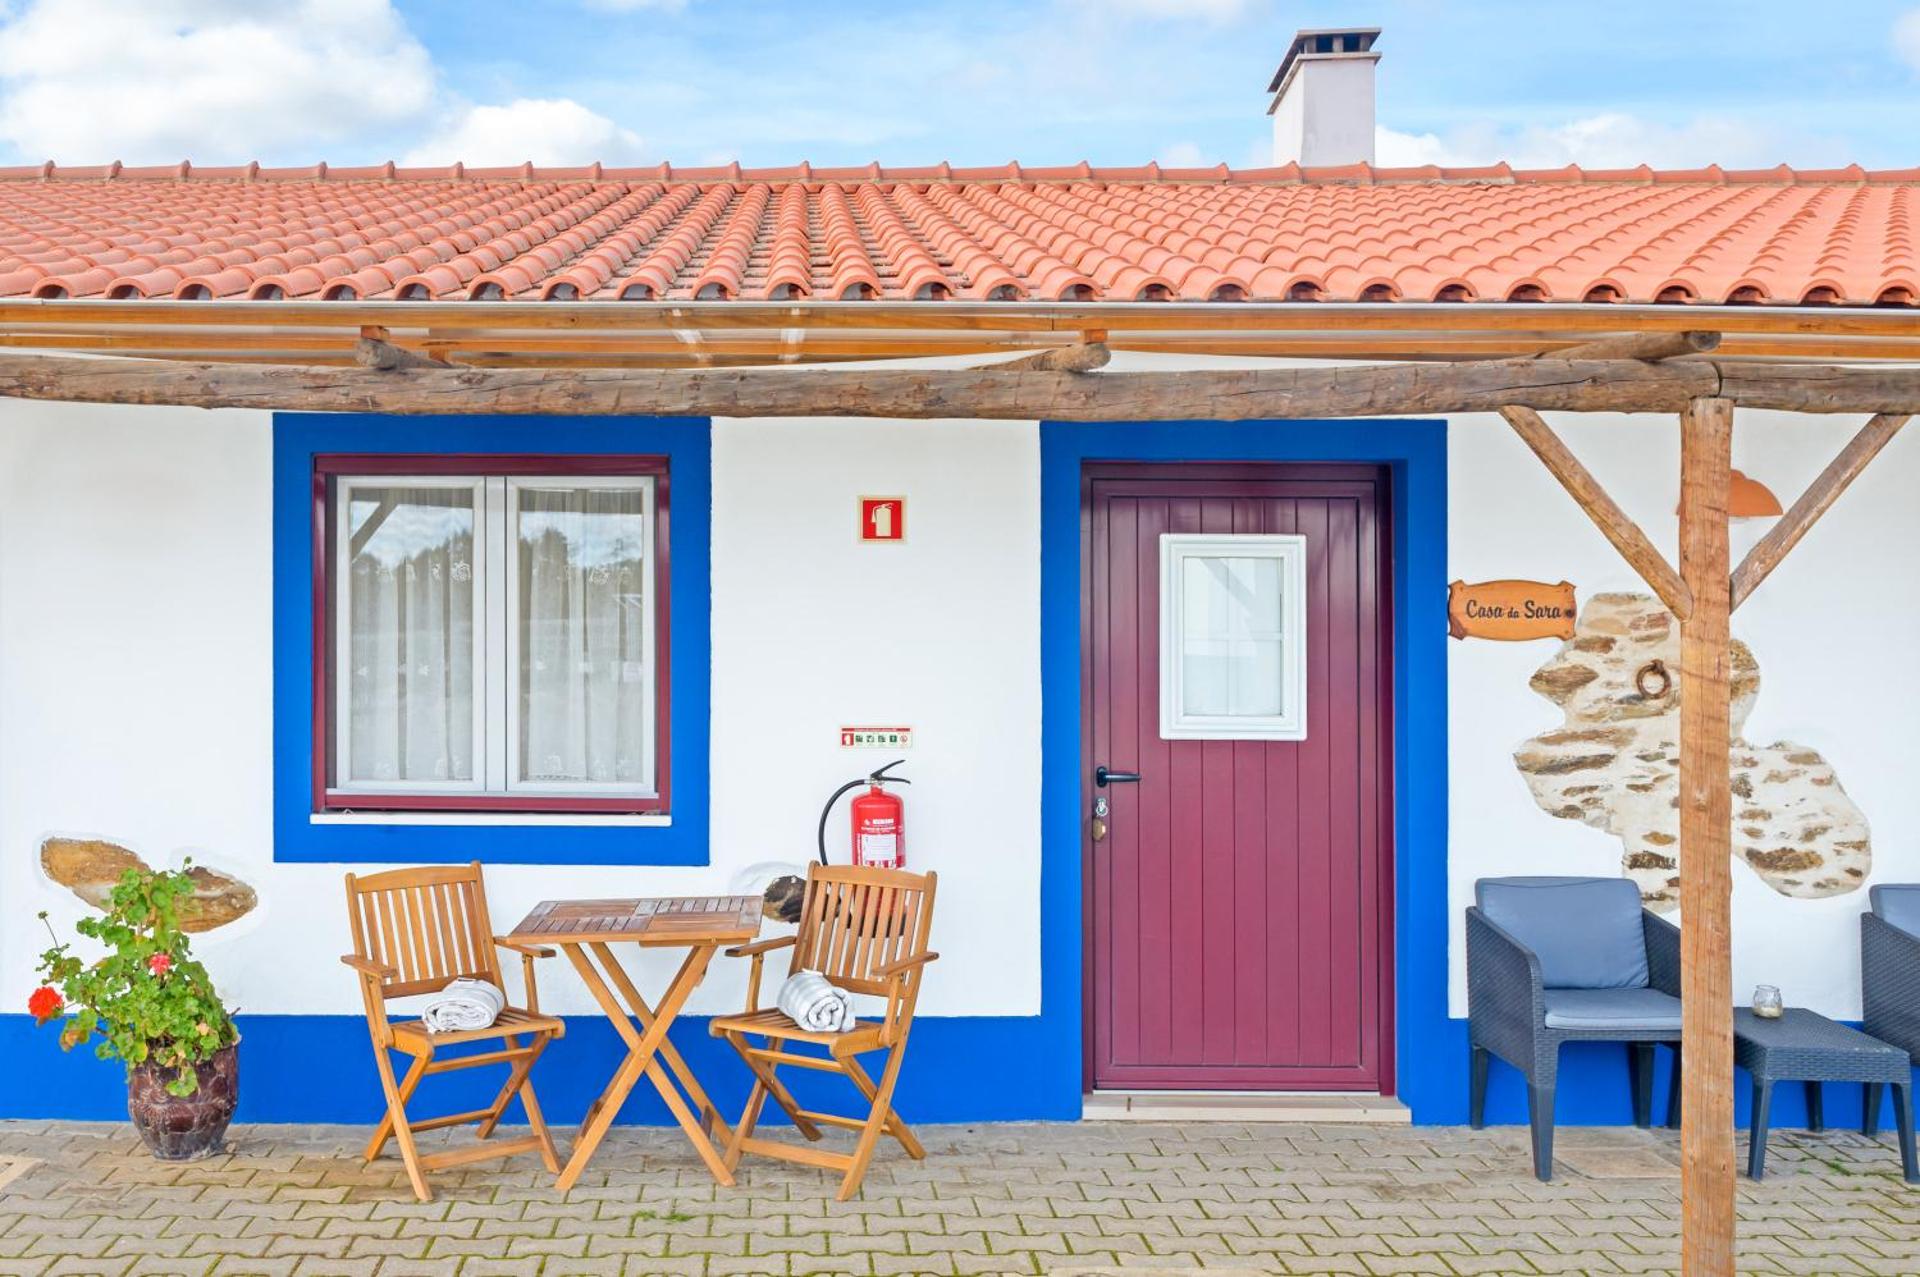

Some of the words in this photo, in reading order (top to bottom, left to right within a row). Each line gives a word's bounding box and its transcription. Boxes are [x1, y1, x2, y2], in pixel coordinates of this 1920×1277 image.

[1466, 599, 1503, 618] Casa
[1507, 607, 1519, 618] da
[1524, 599, 1561, 619] Sara
